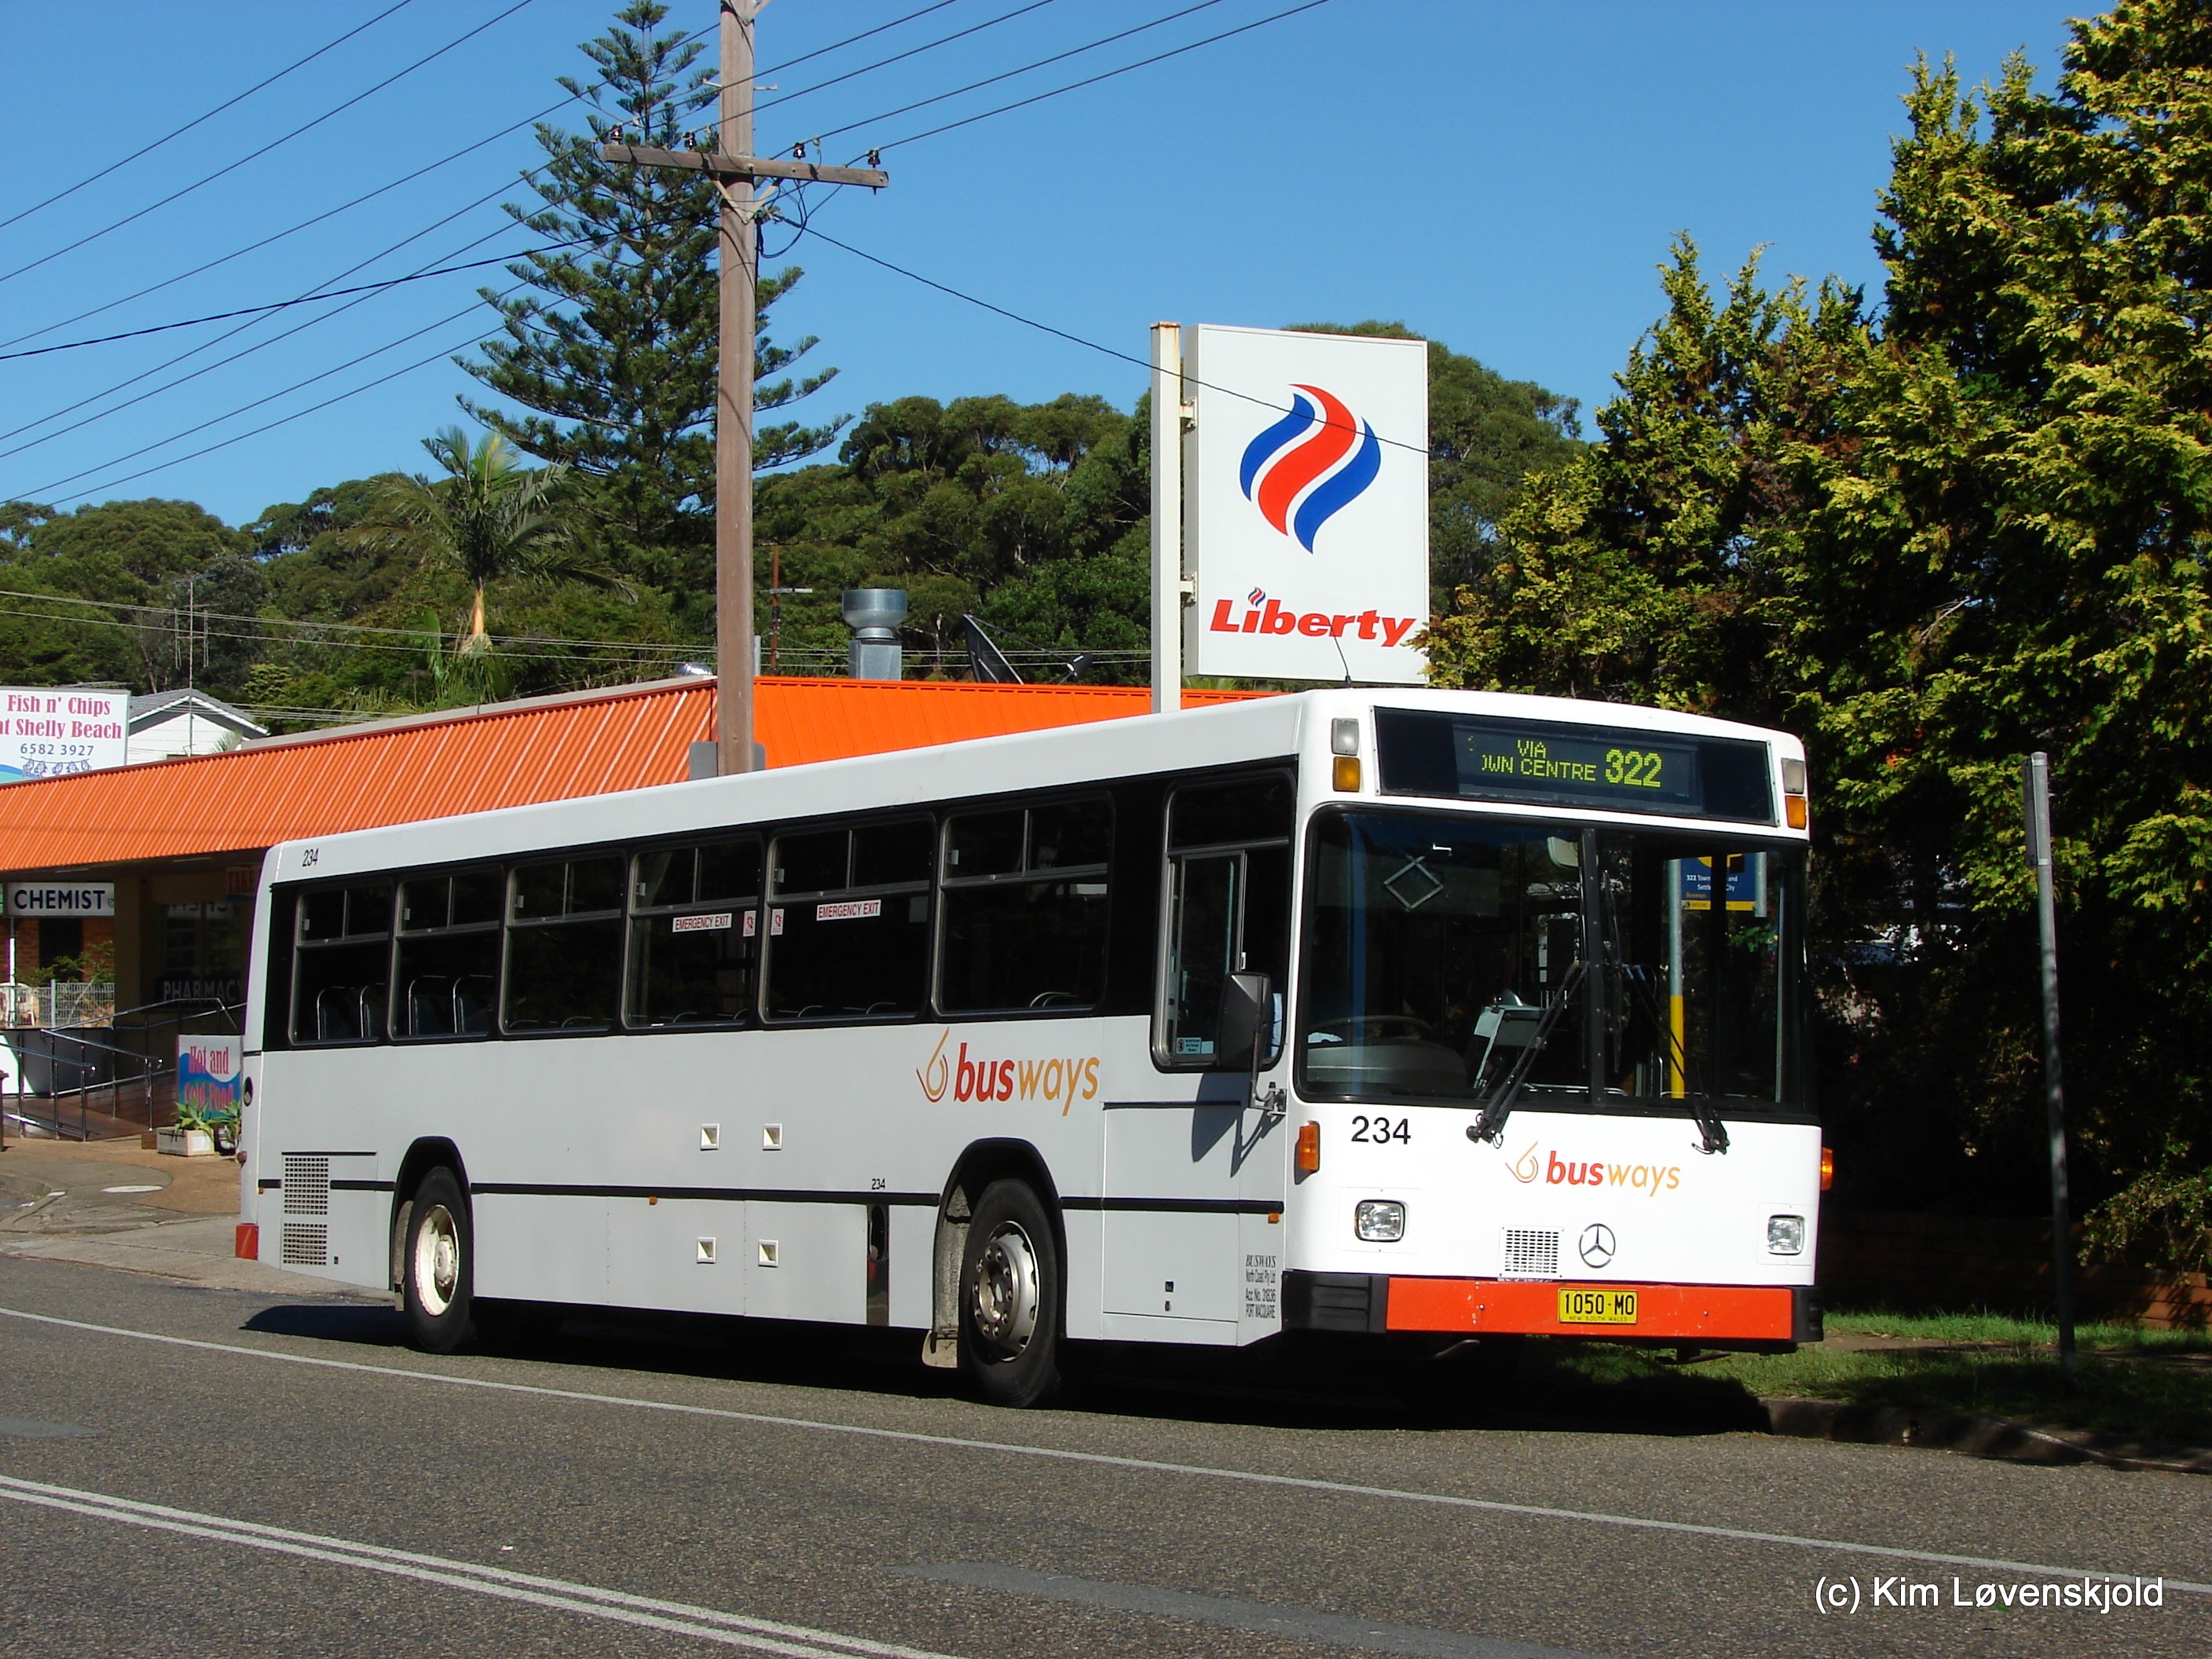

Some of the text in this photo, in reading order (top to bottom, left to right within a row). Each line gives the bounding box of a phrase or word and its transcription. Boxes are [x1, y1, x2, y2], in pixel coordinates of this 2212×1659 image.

[1210, 587, 1417, 647] Liberty
[7, 694, 41, 713] Fish
[68, 697, 111, 716] Chips
[16, 720, 66, 739] Shelly
[71, 721, 122, 740] Beach
[20, 743, 94, 756] 6582 3927
[1517, 739, 1547, 759] VIA
[1520, 759, 1597, 782] CENTRE
[1606, 749, 1662, 788] 322
[302, 848, 319, 867] 234
[14, 890, 106, 910] CHEMIST
[818, 902, 880, 919] EMERGENCY EXIT
[675, 915, 730, 930] EMERGENCY EXIT
[189, 1046, 229, 1075] Hot and
[954, 1042, 1101, 1116] busways
[1350, 1115, 1412, 1144] 234
[1545, 1150, 1681, 1196] busways
[872, 1178, 885, 1190] 234
[1245, 1254, 1276, 1268] BUSWAYS
